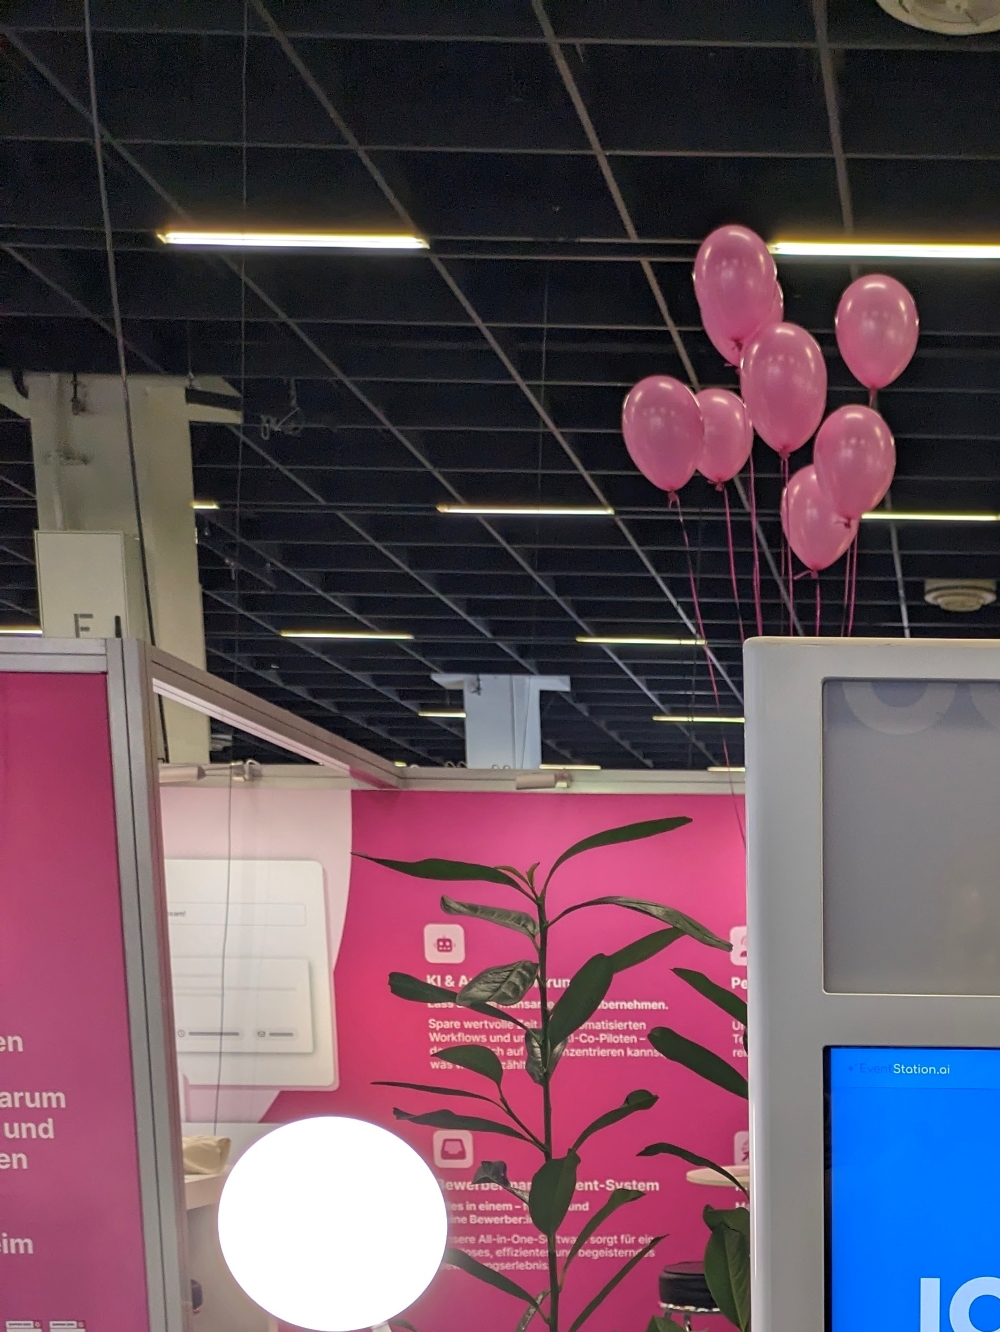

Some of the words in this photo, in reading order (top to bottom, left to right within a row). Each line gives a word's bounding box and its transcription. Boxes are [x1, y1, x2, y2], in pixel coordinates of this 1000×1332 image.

[426, 975, 441, 987] KI
[445, 975, 455, 987] &
[598, 999, 669, 1010] bernehmen.
[428, 1019, 461, 1030] Spare
[463, 1019, 514, 1029] wertvolle
[429, 1033, 487, 1043] Workflows
[489, 1033, 511, 1043] und
[506, 1046, 524, 1057] auf
[4, 1118, 54, 1139] und
[466, 1201, 476, 1211] in
[478, 1201, 513, 1211] einem
[0, 1232, 34, 1254] im
[590, 1235, 618, 1246] sorgt
[620, 1235, 637, 1244] für
